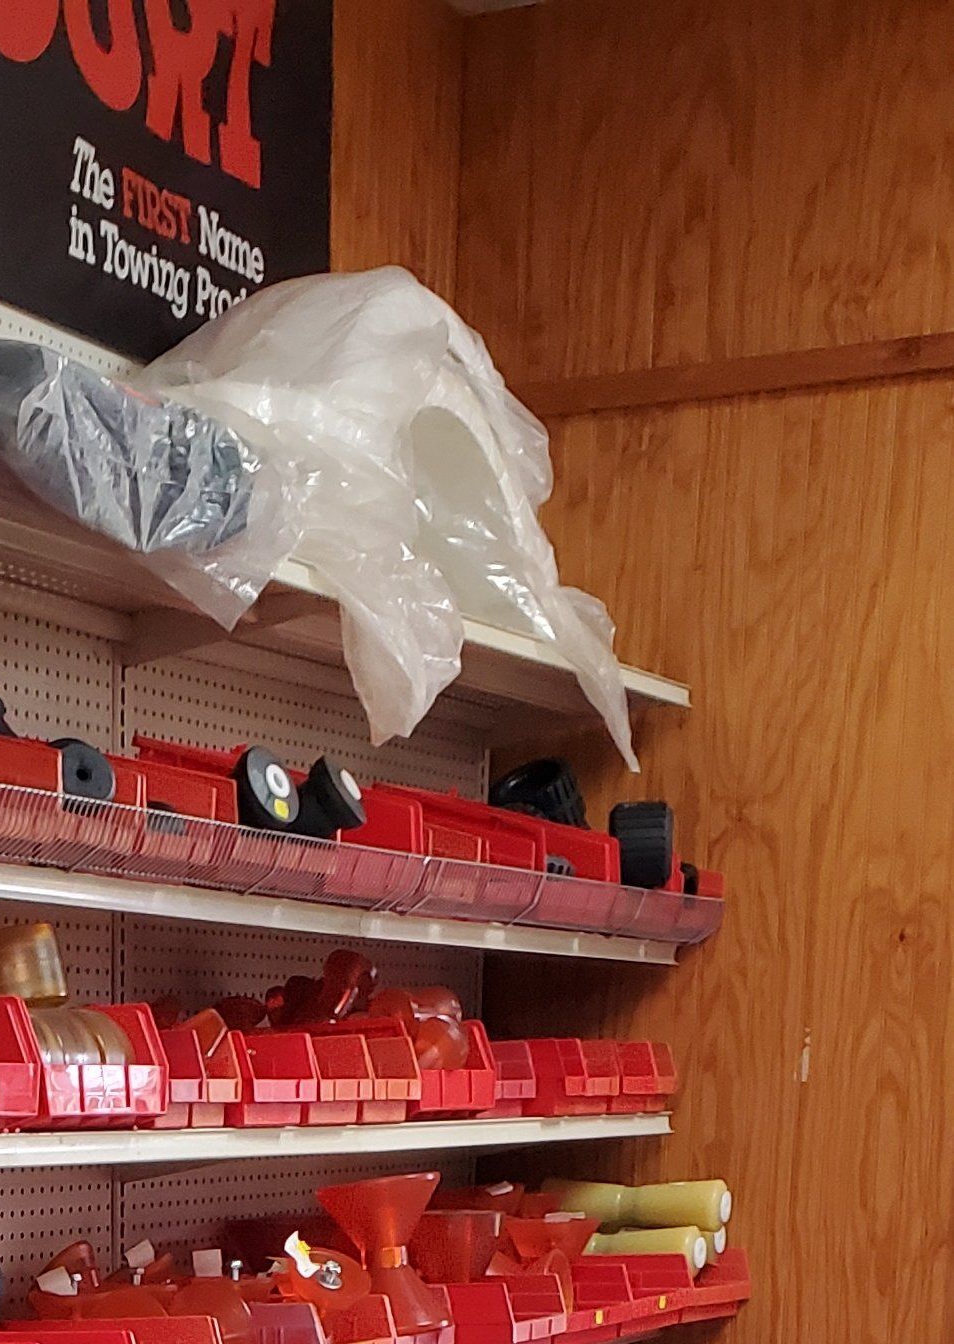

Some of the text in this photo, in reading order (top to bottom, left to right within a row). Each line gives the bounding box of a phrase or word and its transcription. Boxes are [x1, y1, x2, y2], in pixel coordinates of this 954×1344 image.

[68, 204, 247, 318] in Towing Prod
[70, 136, 265, 283] The FIRST Name
